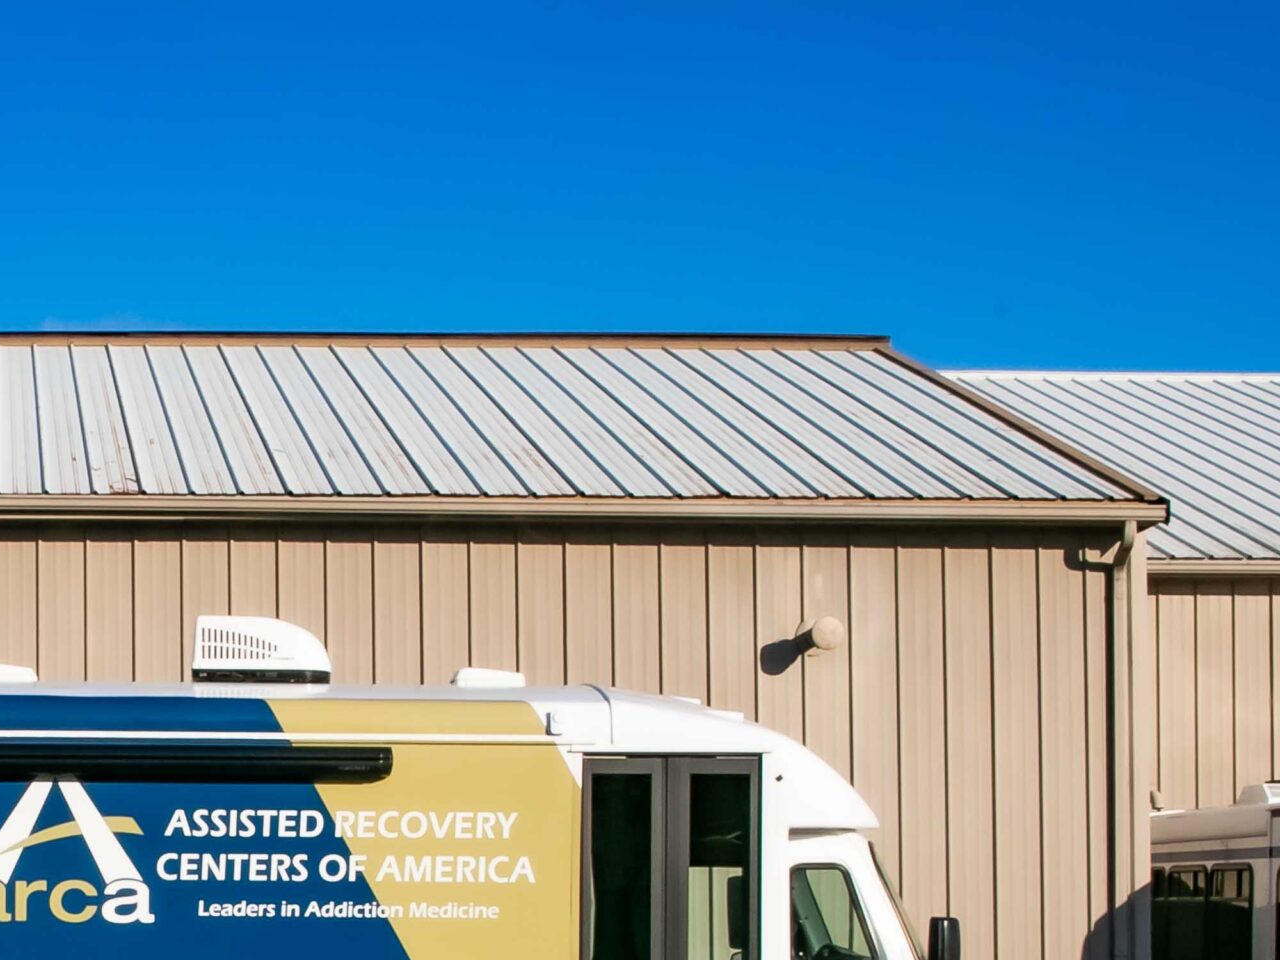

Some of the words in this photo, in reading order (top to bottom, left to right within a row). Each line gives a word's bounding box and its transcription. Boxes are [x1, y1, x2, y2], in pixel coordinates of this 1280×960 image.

[164, 809, 324, 838] ASSISTED
[334, 810, 518, 839] RECOVERY
[156, 853, 309, 882] CENTERS
[318, 853, 367, 882] OF
[375, 855, 536, 884] AMERICA
[197, 900, 276, 918] Leaders
[280, 900, 300, 918] in
[304, 901, 403, 919] Addiction
[409, 902, 500, 919] Medicine
